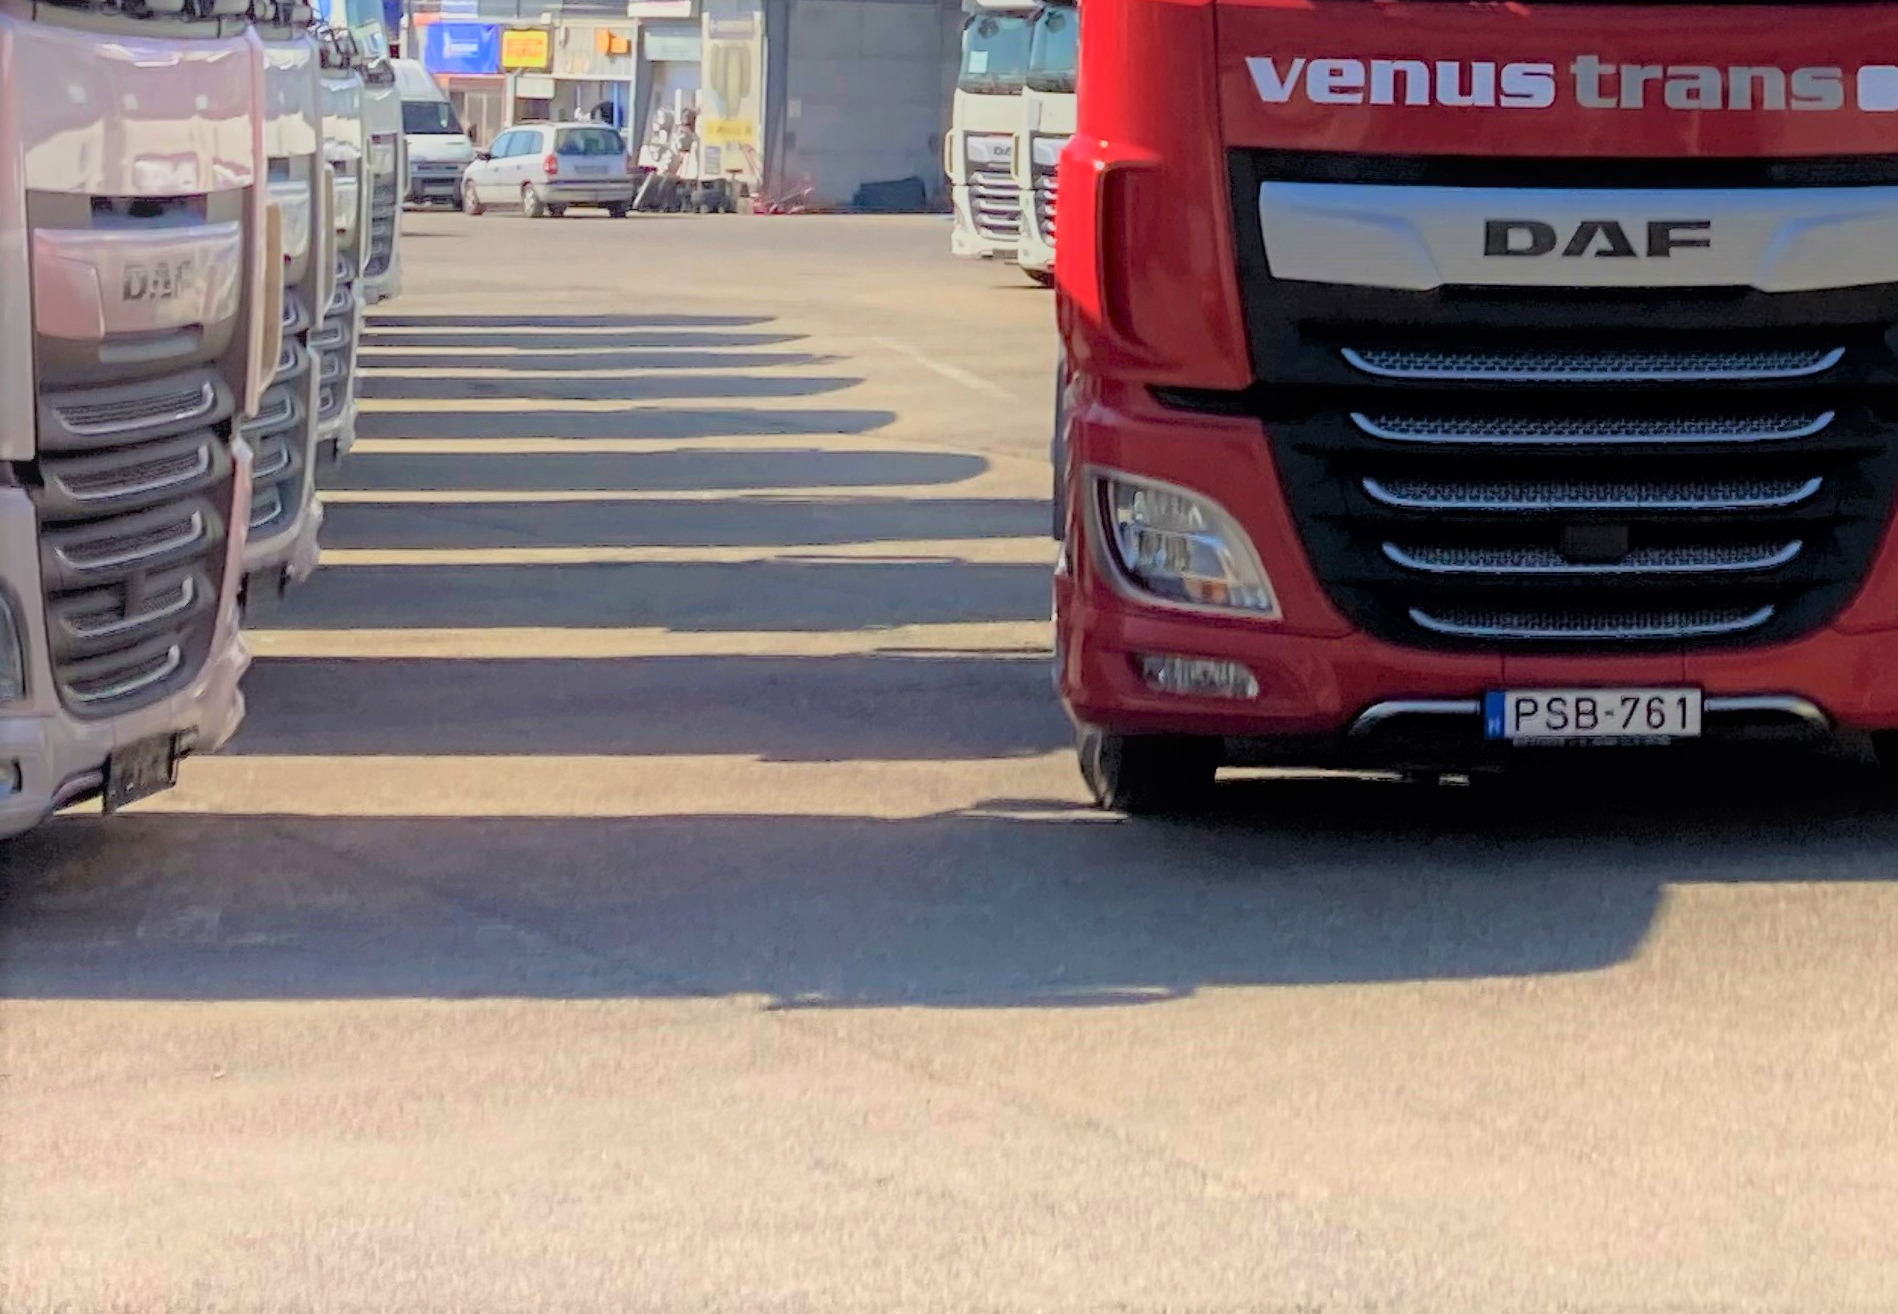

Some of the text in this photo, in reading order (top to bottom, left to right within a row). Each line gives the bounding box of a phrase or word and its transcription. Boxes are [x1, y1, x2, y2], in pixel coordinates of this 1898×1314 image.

[1245, 54, 1843, 111] venus trans
[1484, 219, 1711, 258] DAF
[1514, 694, 1688, 732] PSB-761
